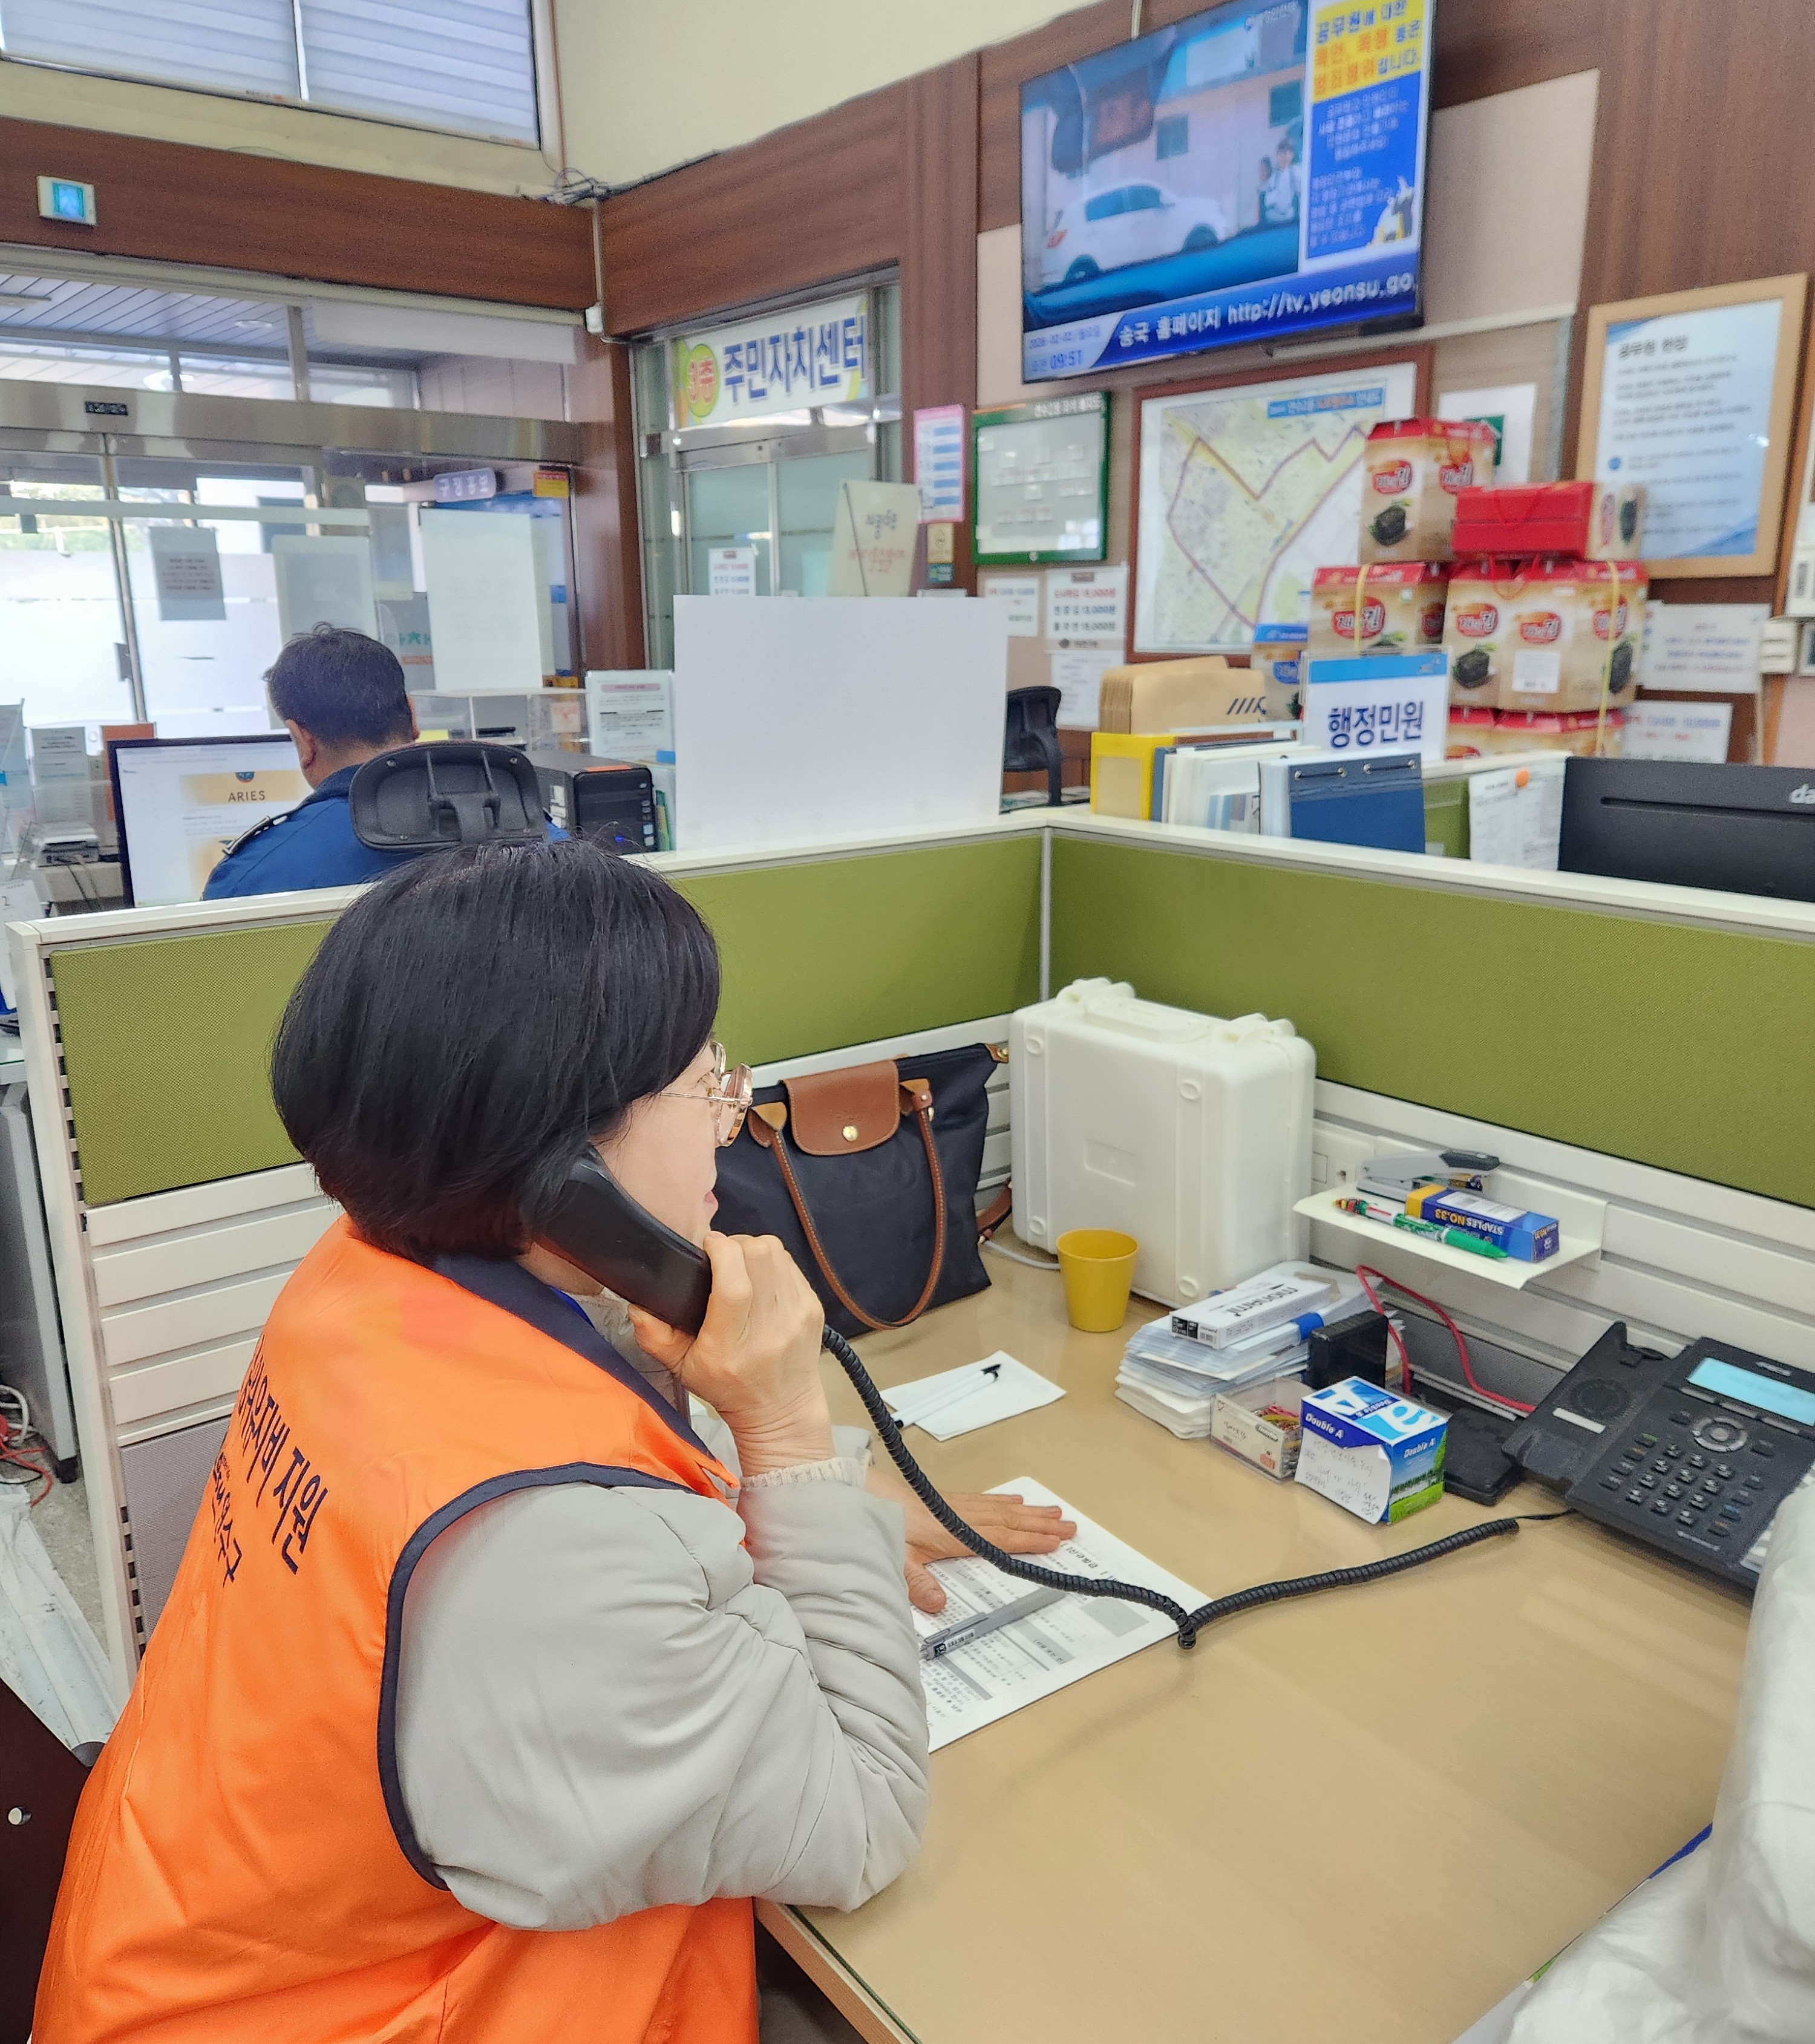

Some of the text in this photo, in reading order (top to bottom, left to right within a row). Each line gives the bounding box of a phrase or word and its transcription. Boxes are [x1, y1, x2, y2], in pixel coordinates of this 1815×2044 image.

[1158, 305, 1220, 342] 홈페이지
[688, 314, 866, 407] 3층 주민자치센터
[1328, 700, 1424, 750] 행정민원
[227, 790, 266, 803] ARIES
[1465, 1216, 1505, 1236] STAPLES
[1304, 1412, 1346, 1440] Double A
[1404, 1437, 1436, 1459] Double A
[271, 1445, 329, 1575] 지원
